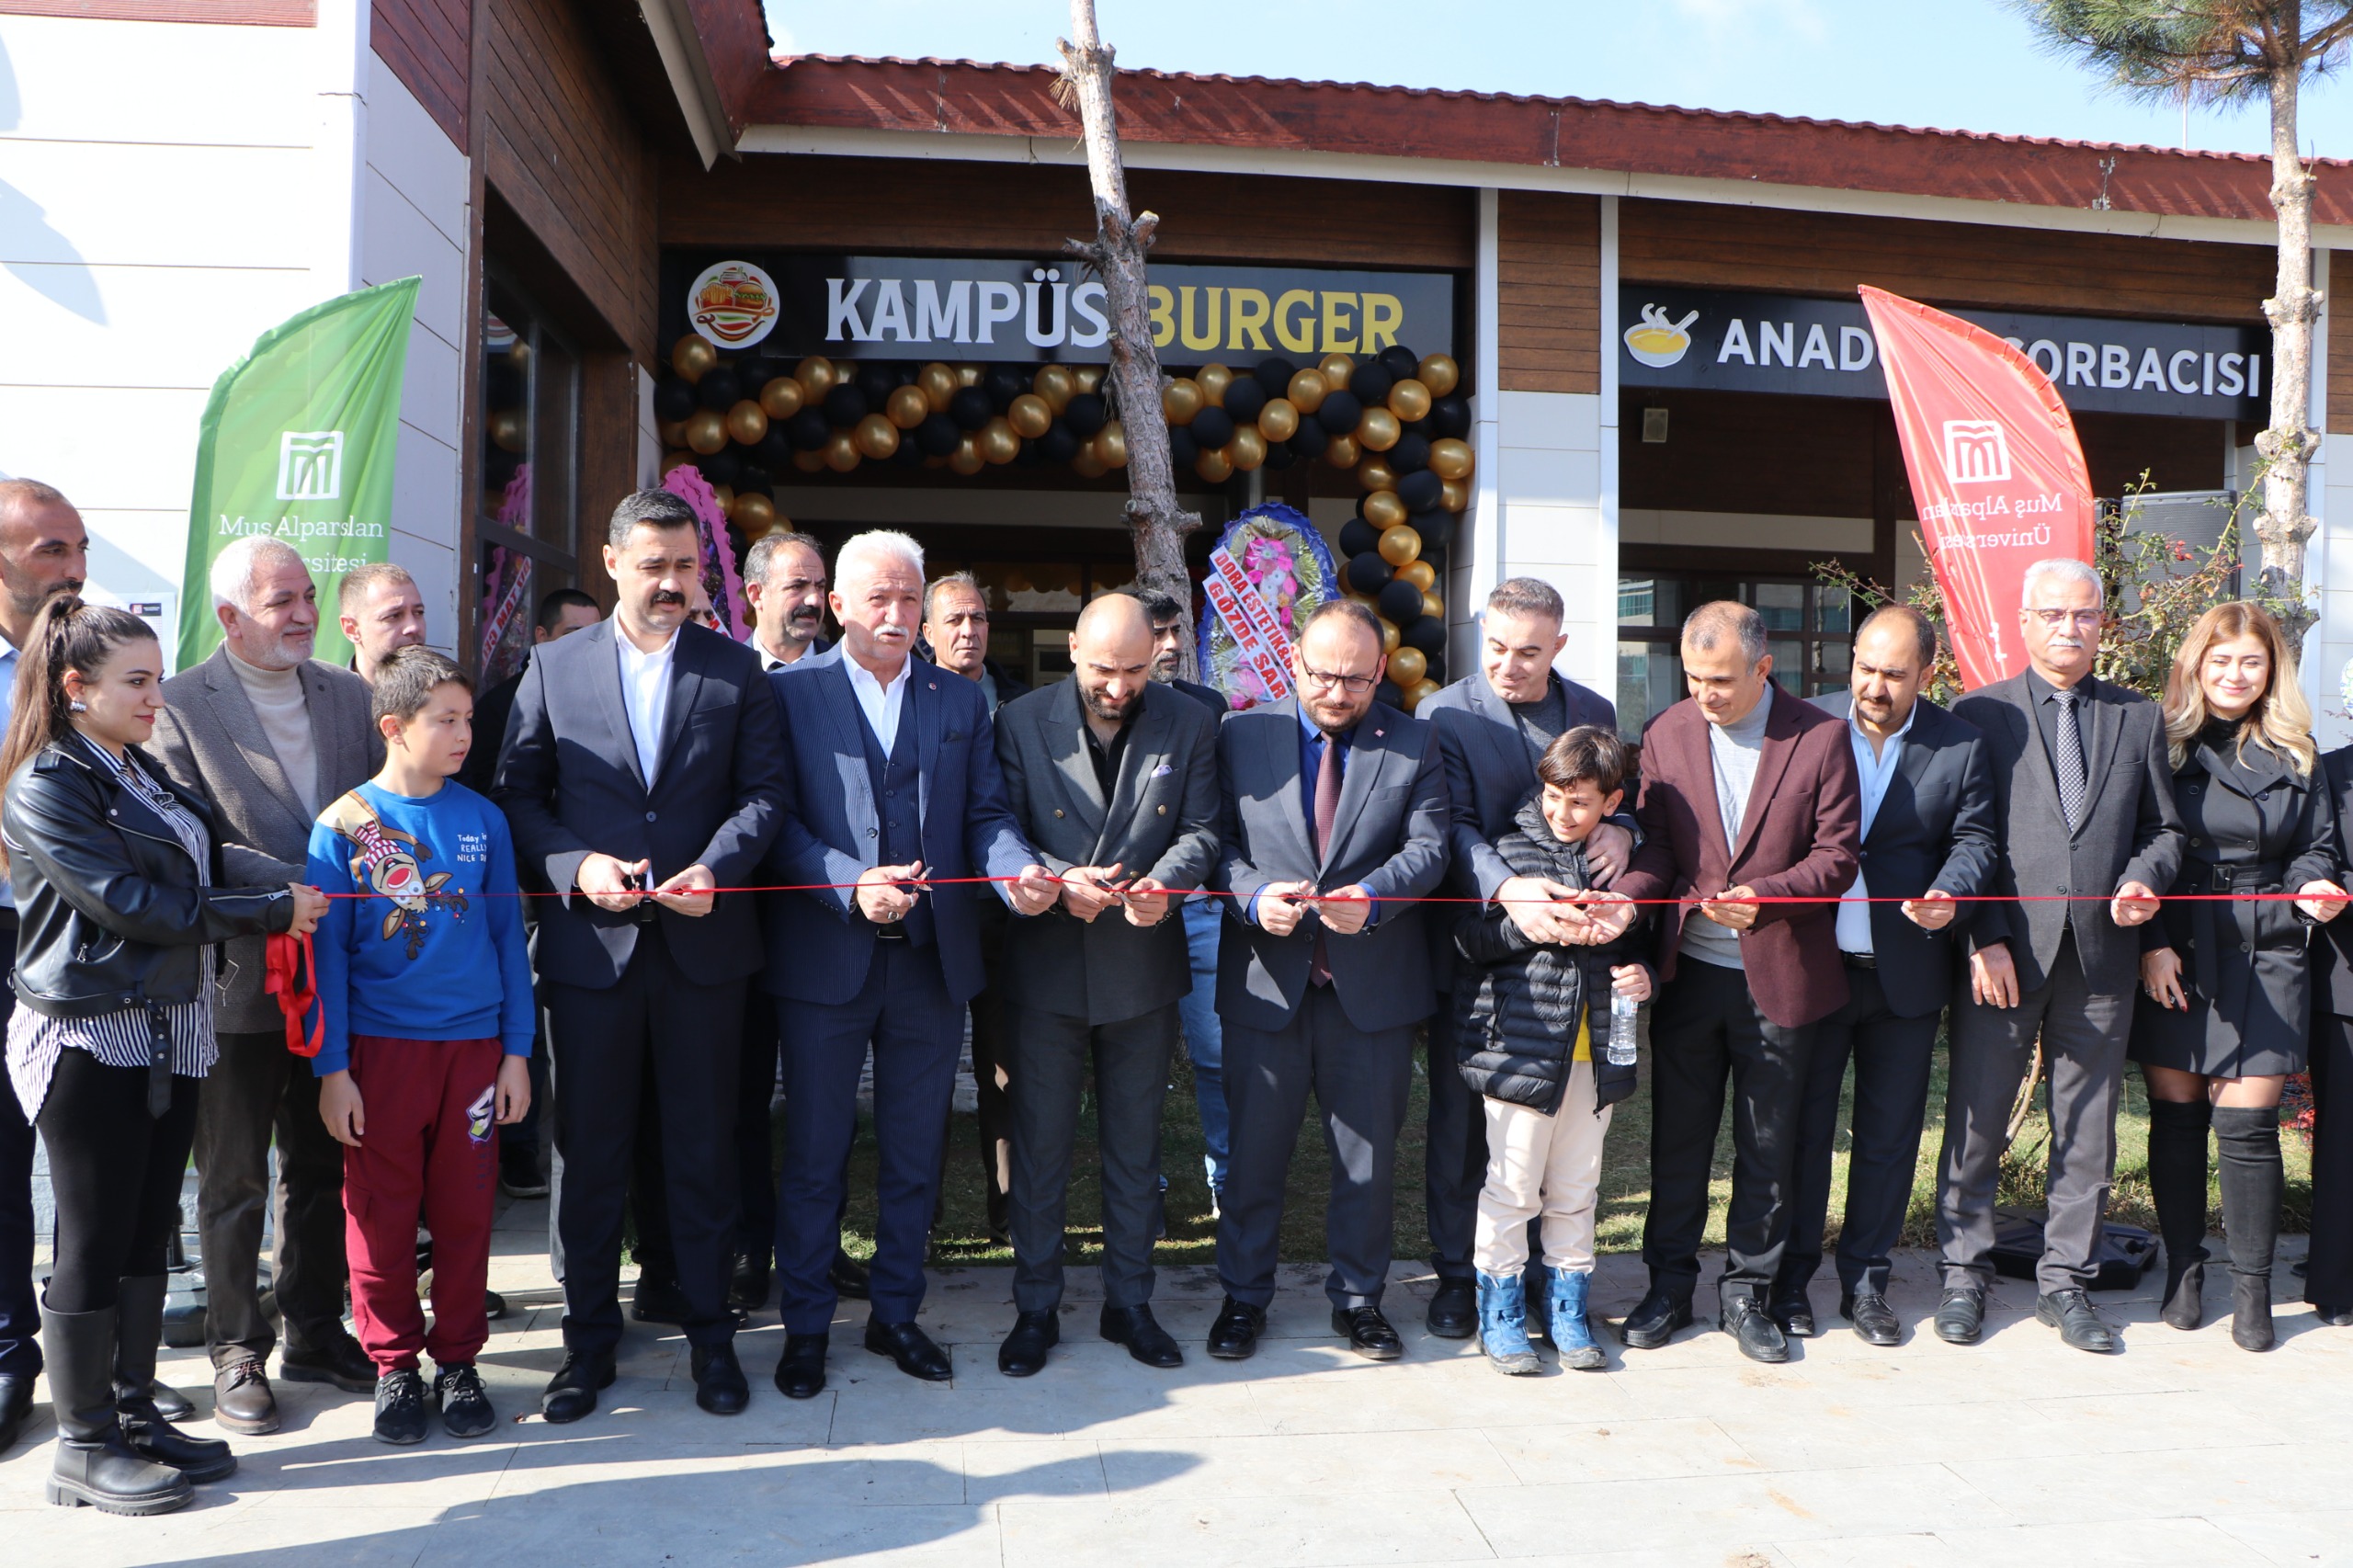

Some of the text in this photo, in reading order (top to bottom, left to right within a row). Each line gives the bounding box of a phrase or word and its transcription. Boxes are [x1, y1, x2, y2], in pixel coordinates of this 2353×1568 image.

[825, 268, 1404, 354] KAMPÜS BURGER
[1716, 318, 1884, 371] ANAD
[274, 515, 384, 542] Alparslan
[1214, 551, 1247, 595] DORA
[1208, 581, 1290, 699] GÖZDE SAR
[457, 834, 479, 844] Today
[457, 854, 476, 862] NICE
